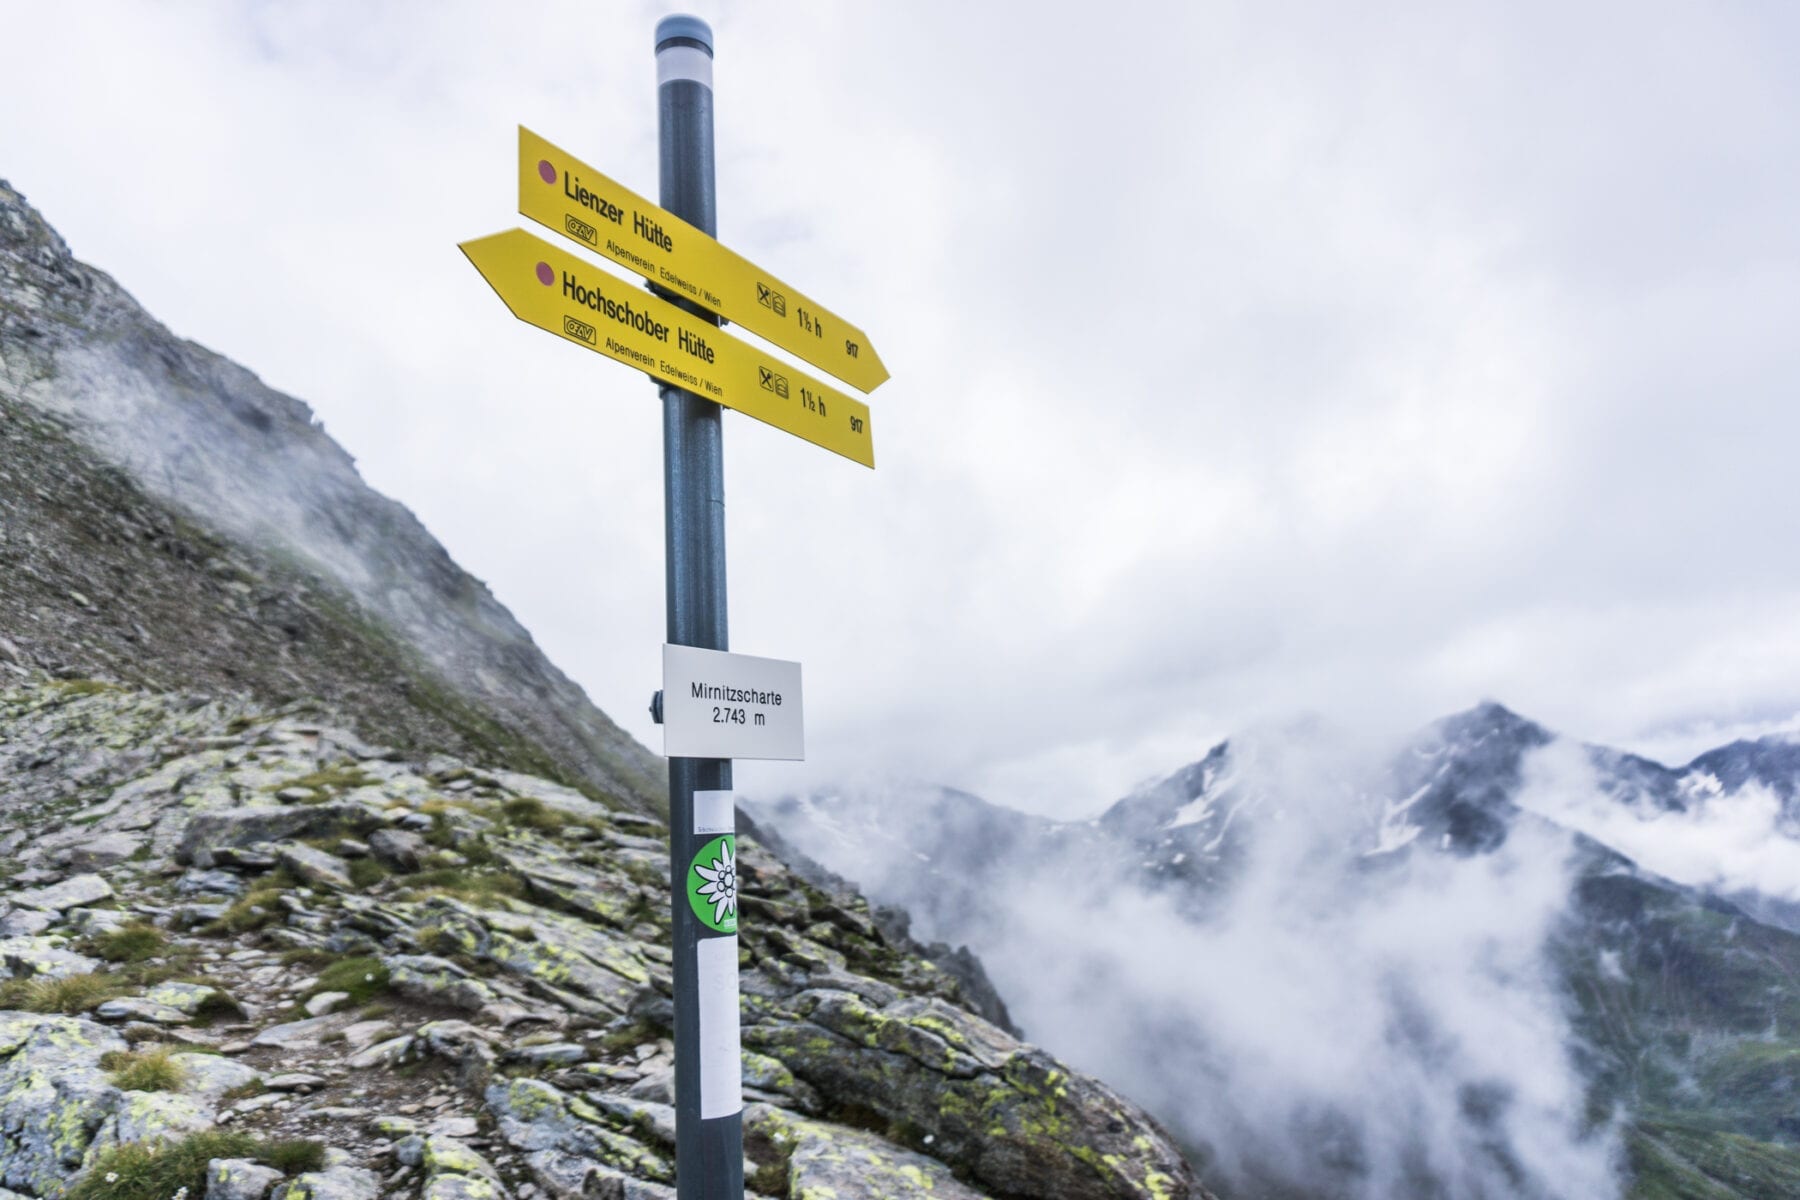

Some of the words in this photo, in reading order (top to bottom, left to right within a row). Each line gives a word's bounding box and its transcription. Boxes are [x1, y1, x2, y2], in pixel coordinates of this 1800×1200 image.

[565, 171, 624, 225] Lienzer
[634, 211, 673, 253] Hütte
[606, 239, 656, 273] Alpenverein
[660, 267, 697, 296] Edelweiss
[703, 290, 722, 307] Wien
[563, 271, 669, 343] Hochschober
[678, 326, 715, 364] Hütte
[815, 317, 822, 338] h
[845, 339, 859, 358] 917
[605, 337, 655, 369] Alpenverein
[660, 360, 698, 386] Edelweiss
[705, 380, 723, 397] Wien
[818, 396, 826, 417] h
[850, 416, 863, 434] 917
[691, 682, 782, 706] Mirnitzscharte
[712, 707, 746, 724] 2.743
[754, 713, 765, 726] m
